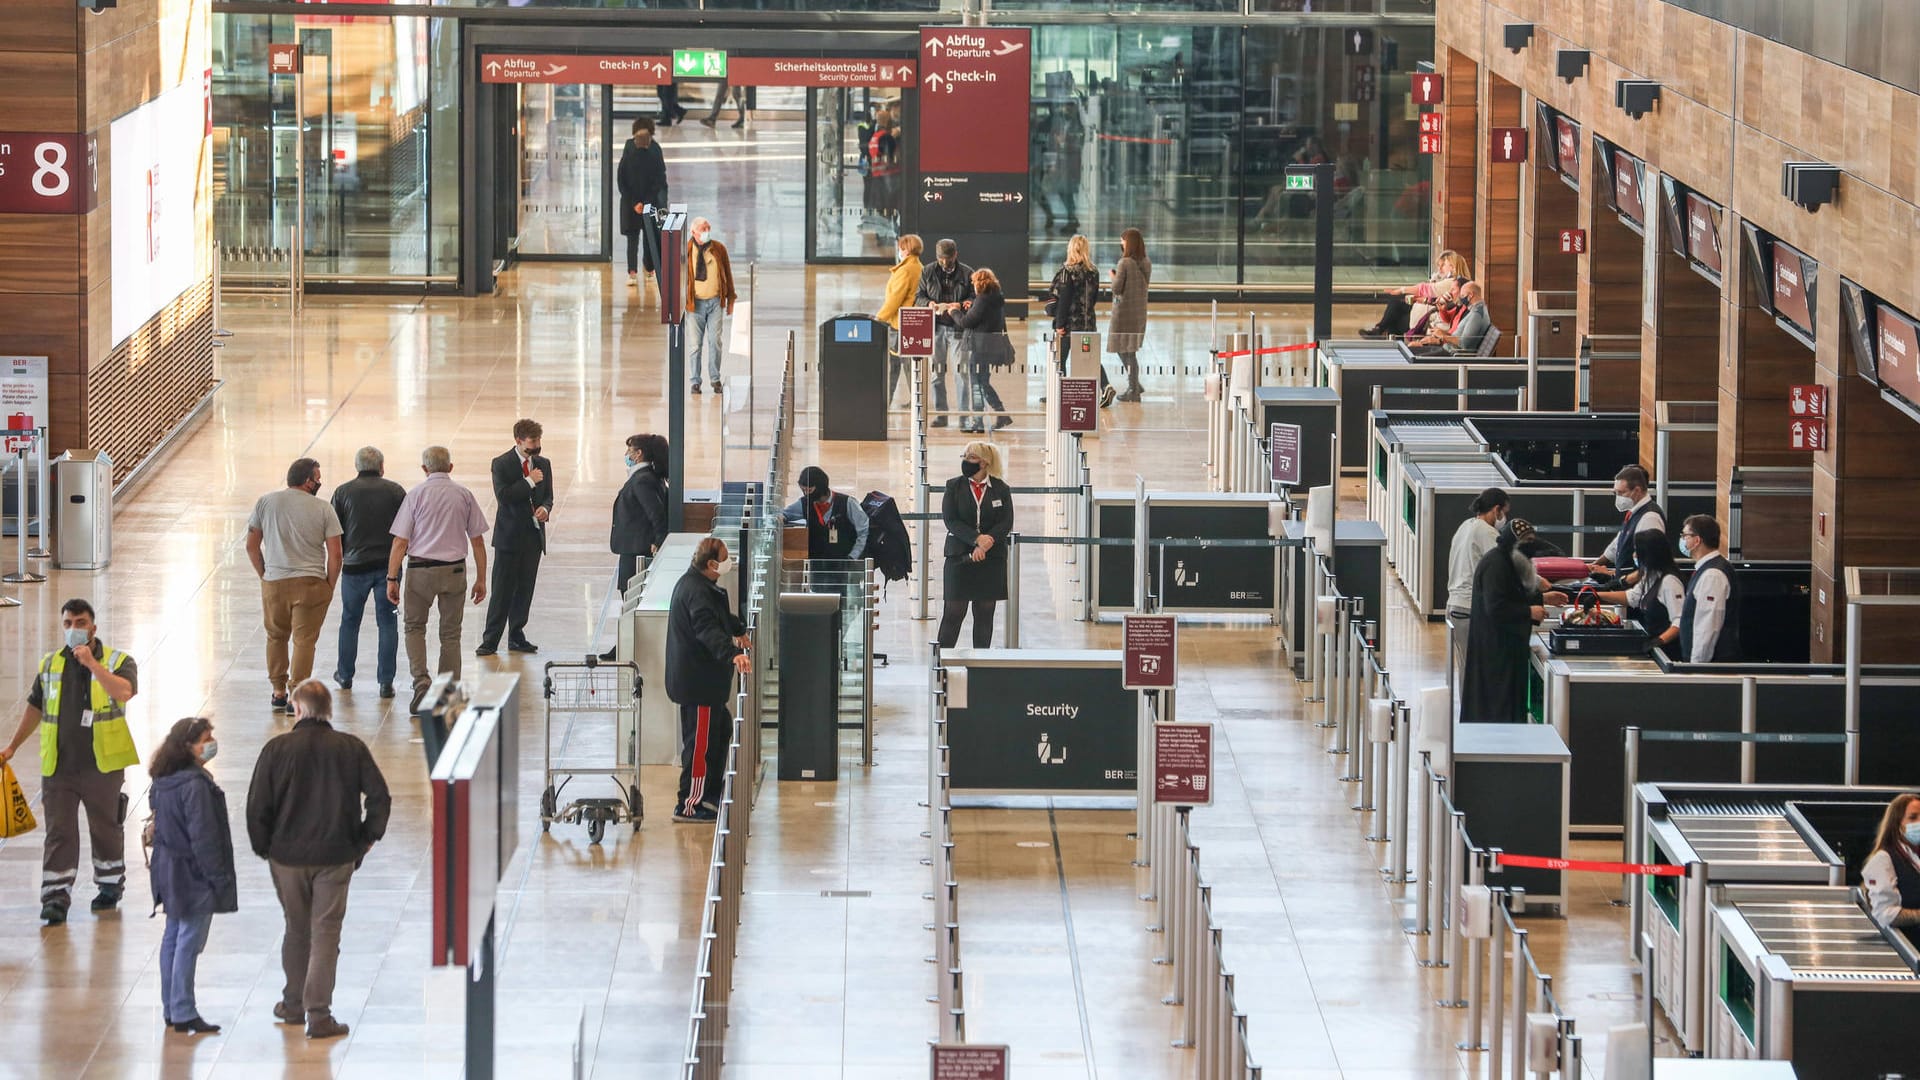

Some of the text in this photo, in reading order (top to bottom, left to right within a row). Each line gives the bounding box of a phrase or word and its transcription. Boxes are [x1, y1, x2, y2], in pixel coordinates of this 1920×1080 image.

[946, 35, 985, 48] Abflug
[947, 48, 991, 59] Departure
[503, 59, 536, 71] Abflug
[600, 60, 649, 70] Check-in 9
[774, 62, 877, 72] Sicherheitskontrolle 5
[504, 69, 540, 78] Departure
[819, 73, 877, 82] Security Control
[946, 70, 996, 82] Check-in
[946, 83, 953, 94] 9
[32, 142, 70, 196] 8
[1026, 704, 1079, 719] Security
[1104, 770, 1124, 779] BER
[1548, 860, 1569, 868] STOP
[1640, 865, 1662, 874] STOP
